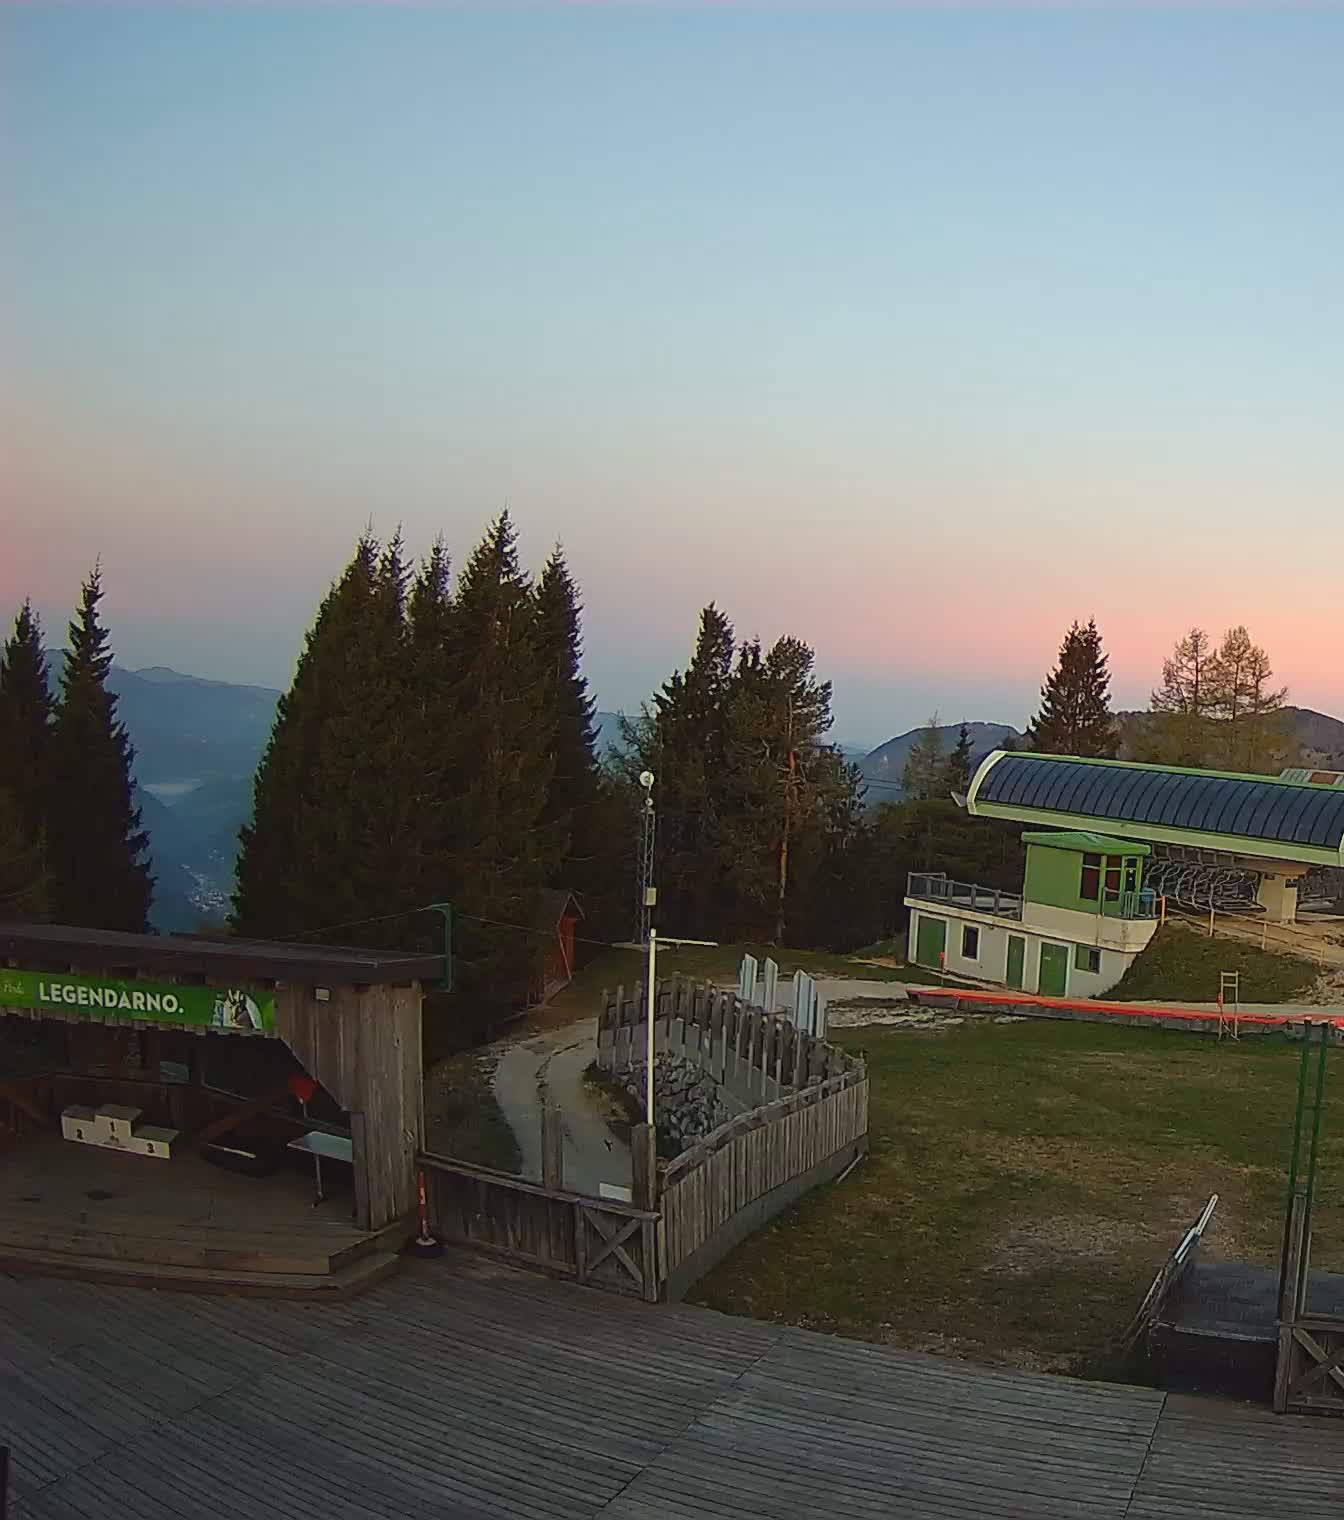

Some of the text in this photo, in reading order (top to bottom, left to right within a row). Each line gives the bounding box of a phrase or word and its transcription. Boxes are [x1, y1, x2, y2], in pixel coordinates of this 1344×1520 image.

[39, 982, 185, 1014] LEGENDARNO.
[76, 1128, 83, 1140] 2
[146, 1142, 154, 1154] 3
